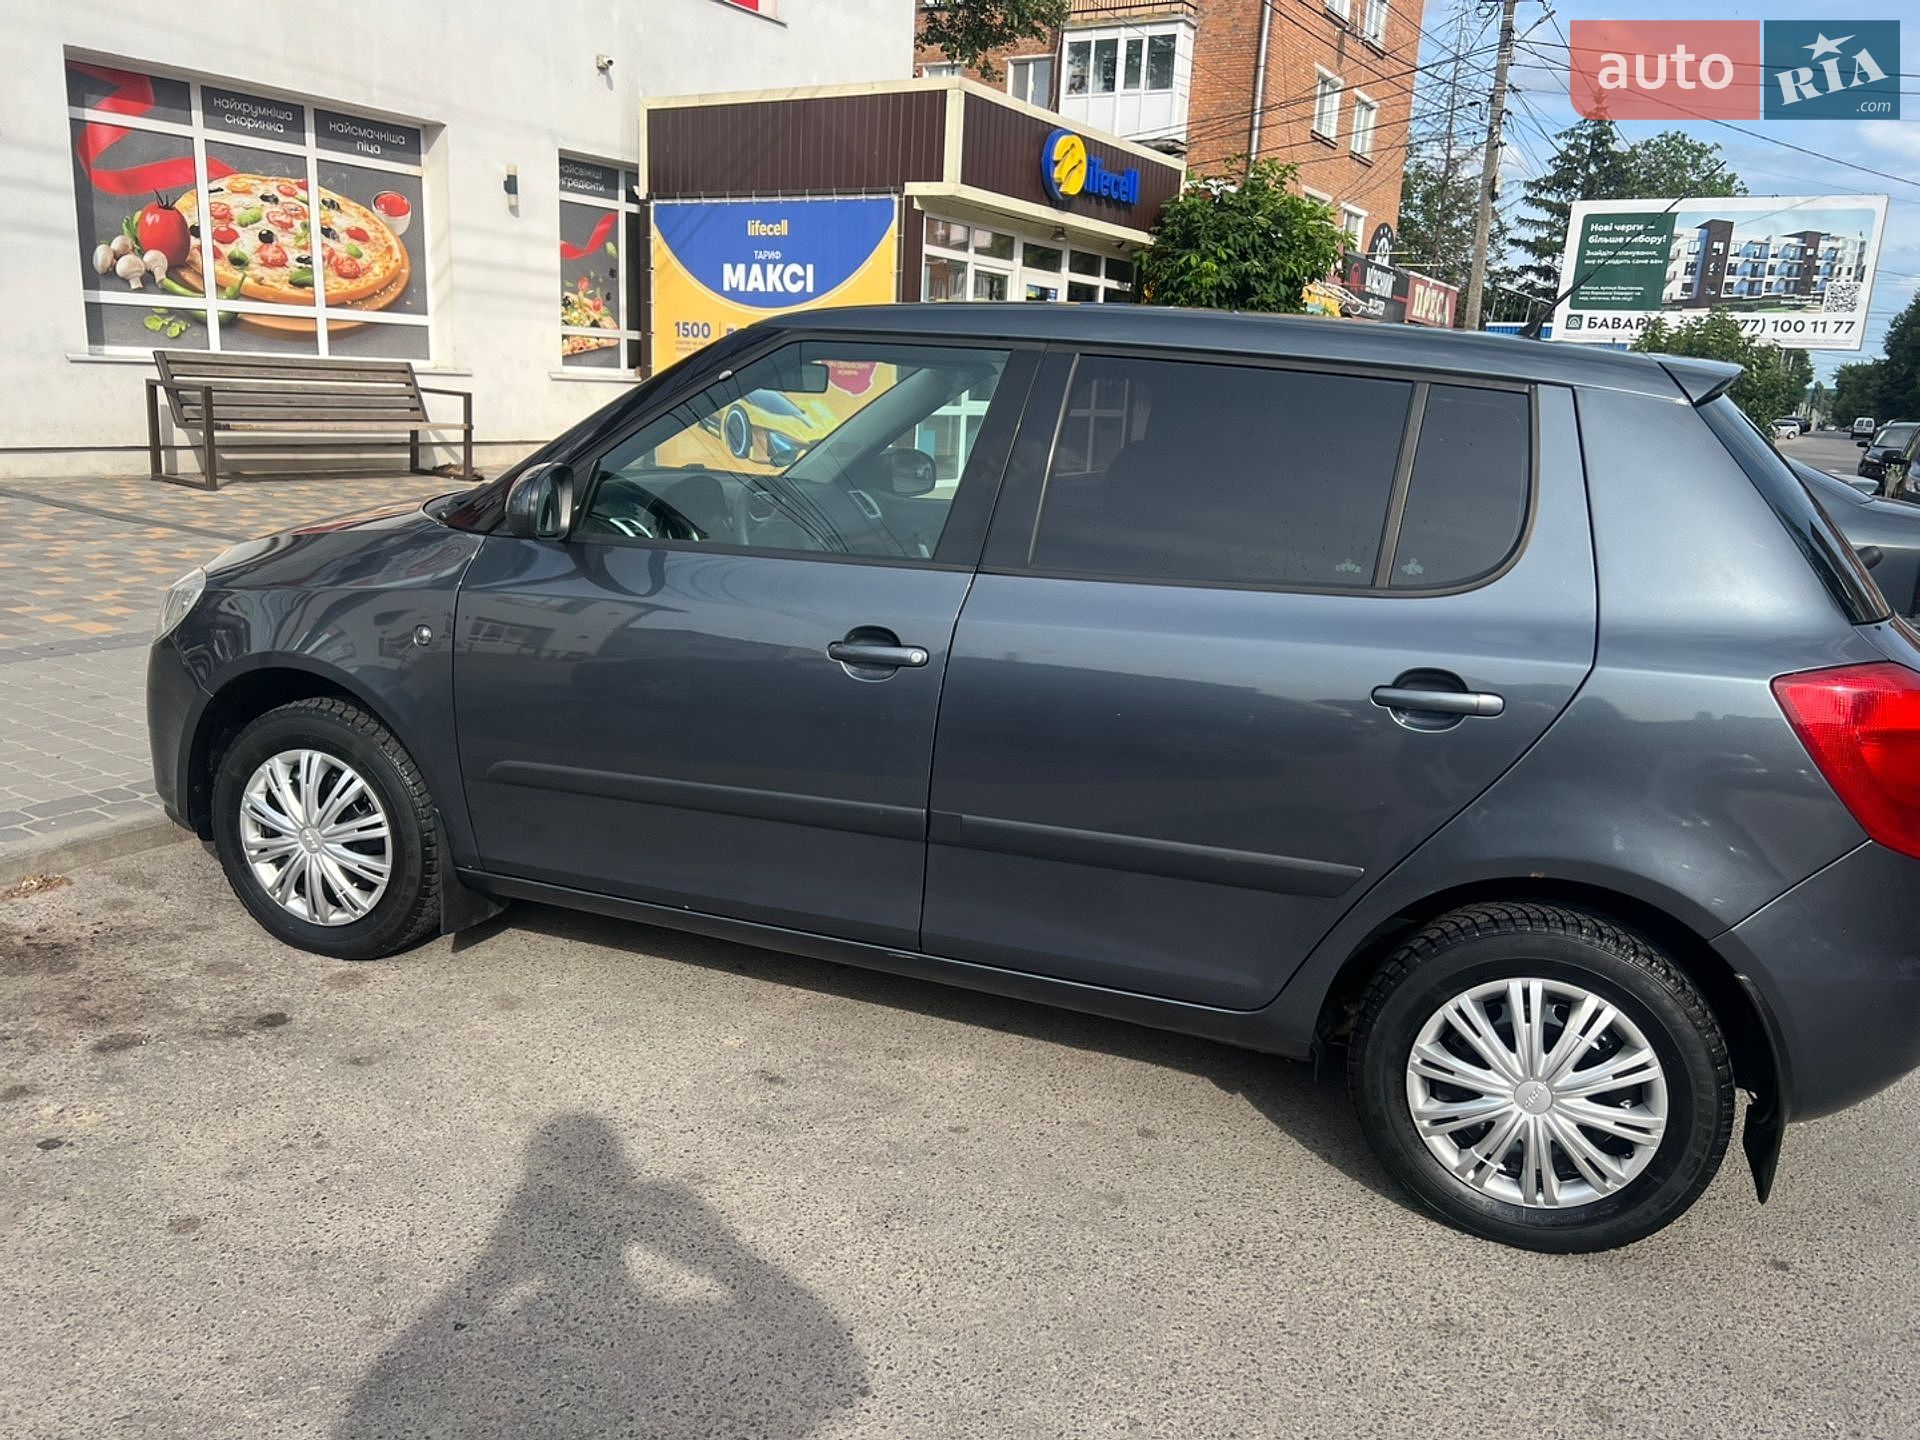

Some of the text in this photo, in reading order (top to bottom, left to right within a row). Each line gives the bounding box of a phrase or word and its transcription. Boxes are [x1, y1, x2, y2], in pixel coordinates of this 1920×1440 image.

[213, 97, 293, 122] найхрумніша
[225, 113, 285, 133] скоринка
[329, 121, 406, 145] найсмачніша
[356, 141, 382, 155] піца
[747, 219, 789, 236] lifecell
[1590, 222, 1613, 232] Нові
[1614, 223, 1644, 233] черги
[1588, 234, 1624, 244] більше
[754, 250, 781, 260] ТАРИФ
[722, 263, 814, 293] МАКСІ
[1412, 283, 1451, 325] ПРЕСА
[674, 321, 711, 338] 1500
[1771, 319, 1806, 333] 100
[1811, 319, 1827, 333] 11
[1833, 320, 1856, 334] 77
